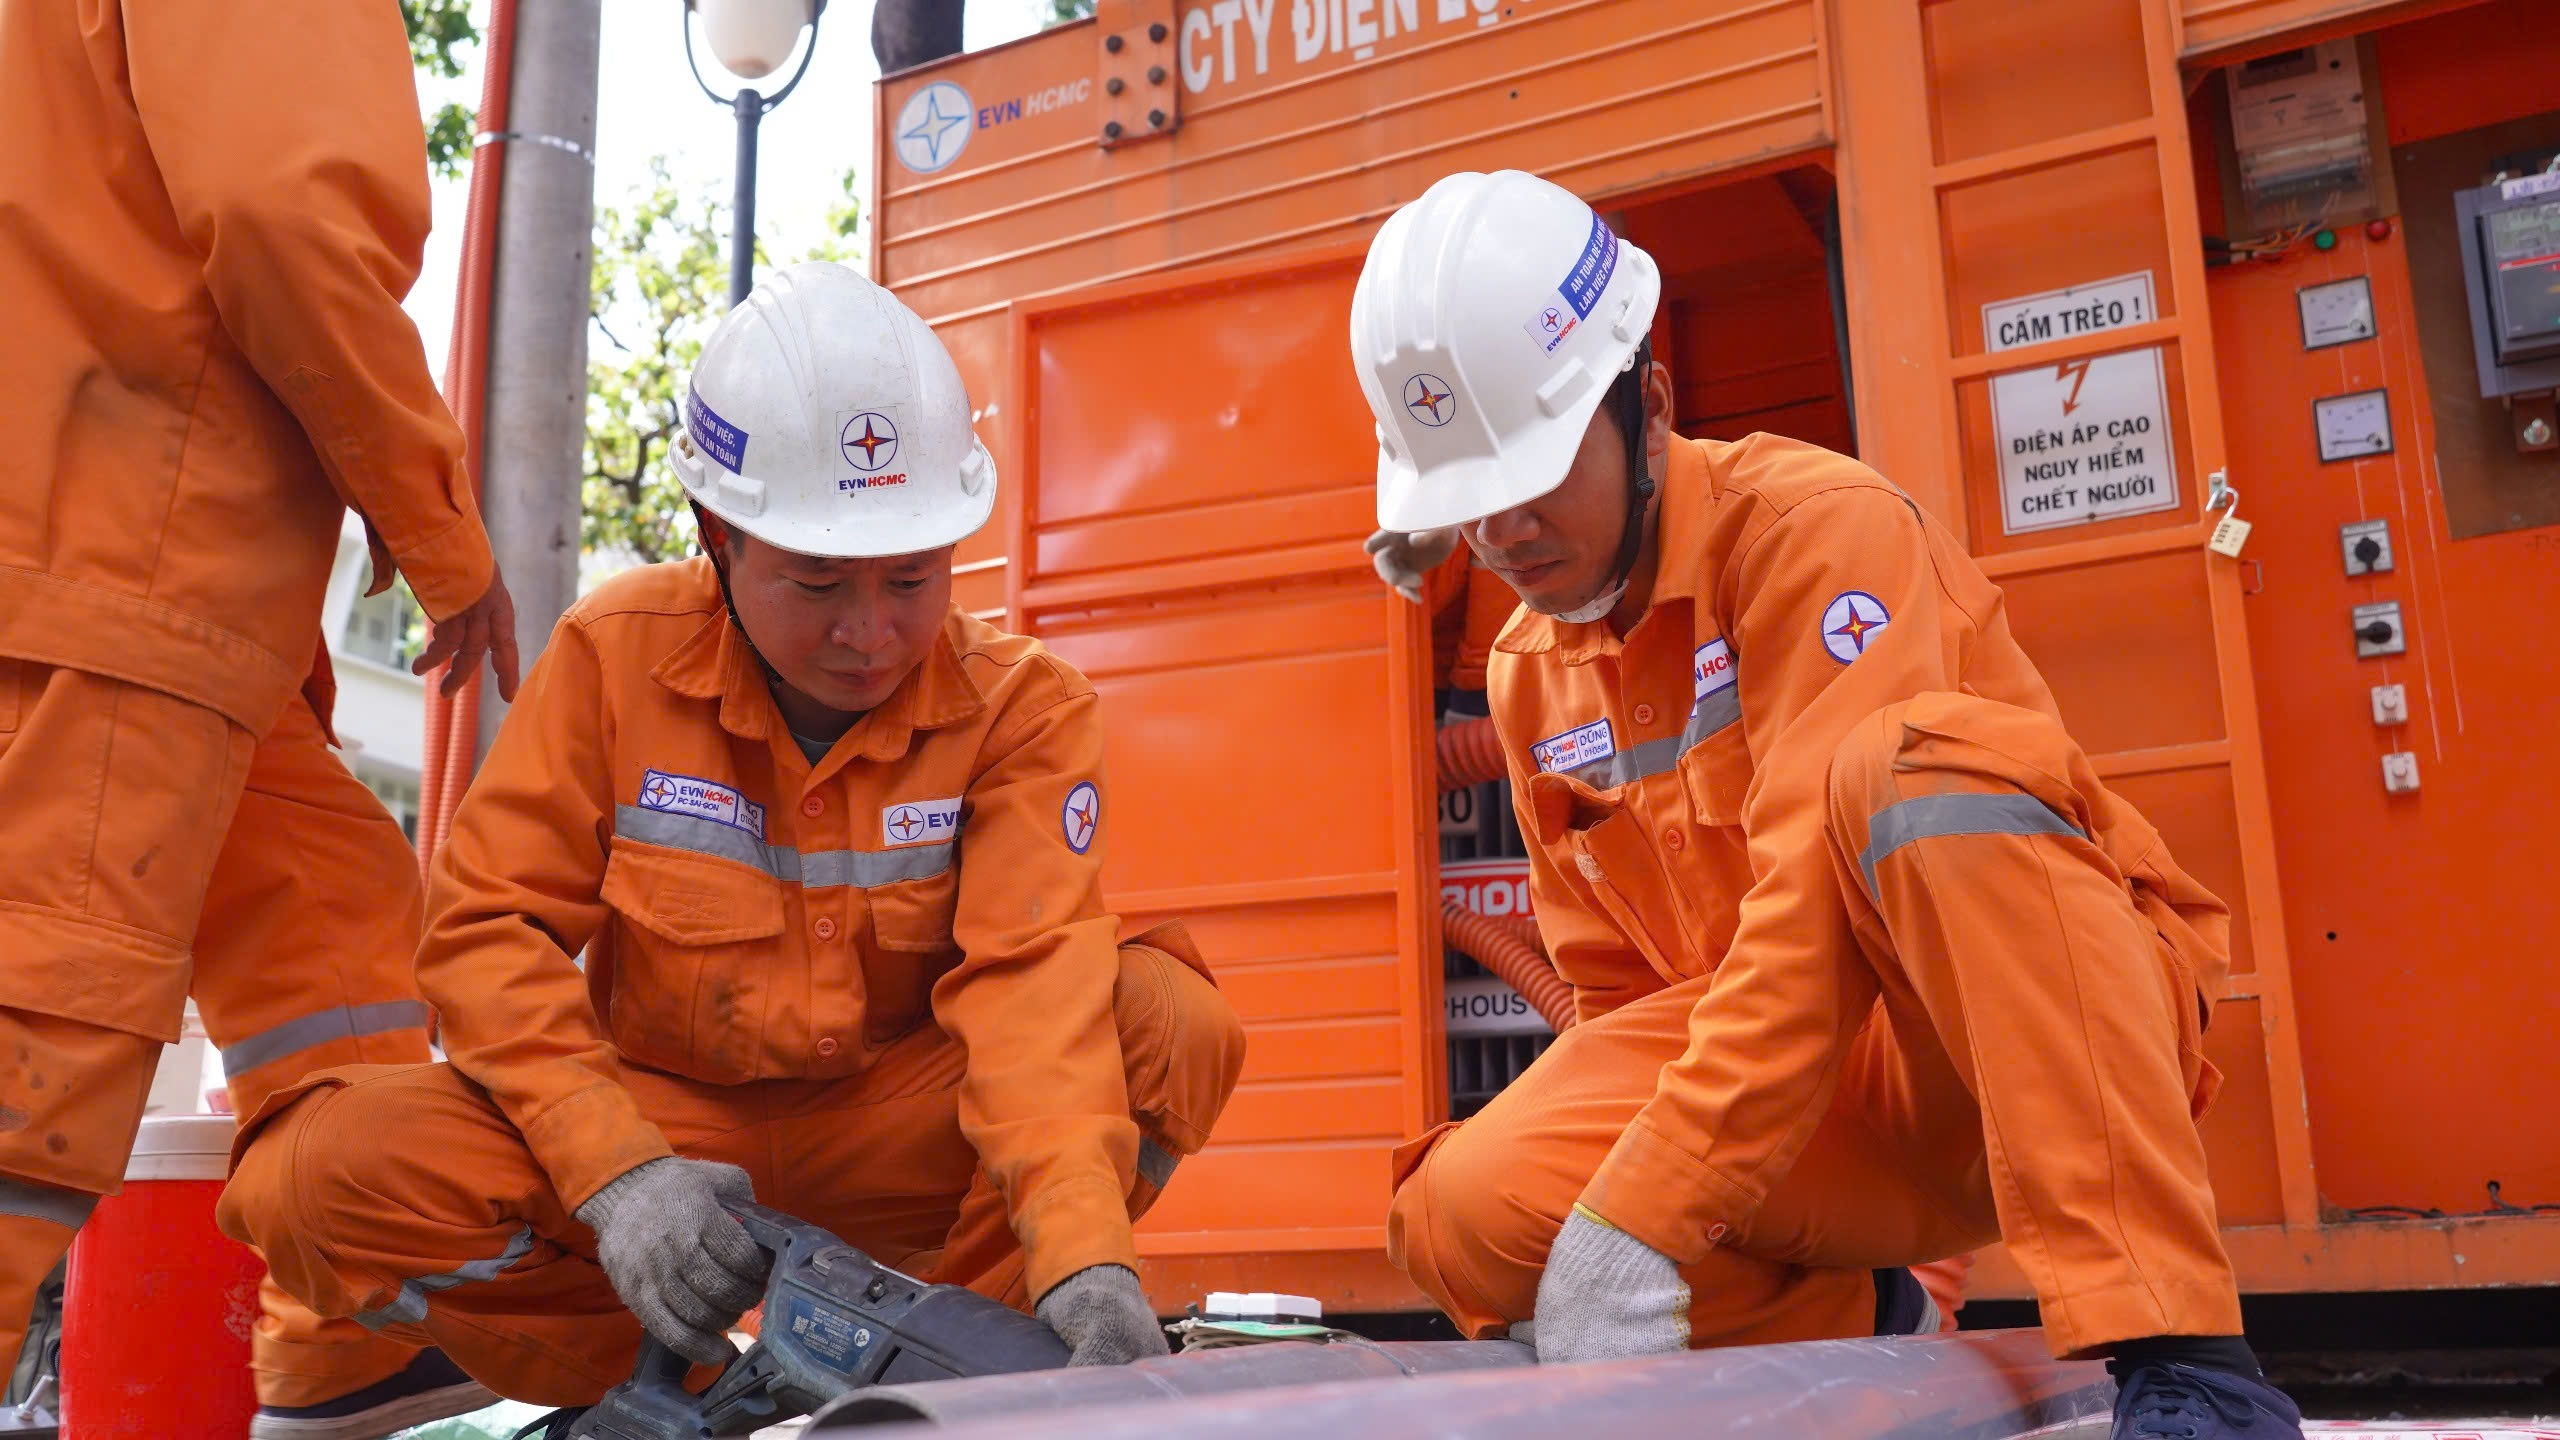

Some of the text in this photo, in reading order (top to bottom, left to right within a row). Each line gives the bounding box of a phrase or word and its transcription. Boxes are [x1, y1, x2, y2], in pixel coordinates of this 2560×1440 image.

[1179, 0, 1274, 94] CTY
[978, 77, 1092, 129] EVN HCMC
[1570, 275, 1584, 294] AN
[1580, 253, 1597, 279] TOÀN
[1579, 286, 1596, 312] LÀM
[1592, 270, 1606, 292] VIỆC
[2000, 307, 2051, 347] CẤM
[2059, 298, 2124, 334] TRÈO
[705, 437, 715, 453] AN
[716, 444, 737, 467] TOÀN
[716, 424, 736, 448] VIỆC,
[2013, 415, 2150, 457] ĐIỆN ÁP CAO
[838, 473, 907, 491] EVNHCMC
[2024, 441, 2145, 483] NGUY HIỂM
[2021, 474, 2155, 514] CHẾT NGƯỜI
[680, 786, 734, 806] EVNHCMC
[1444, 992, 1528, 1019] HOUS
